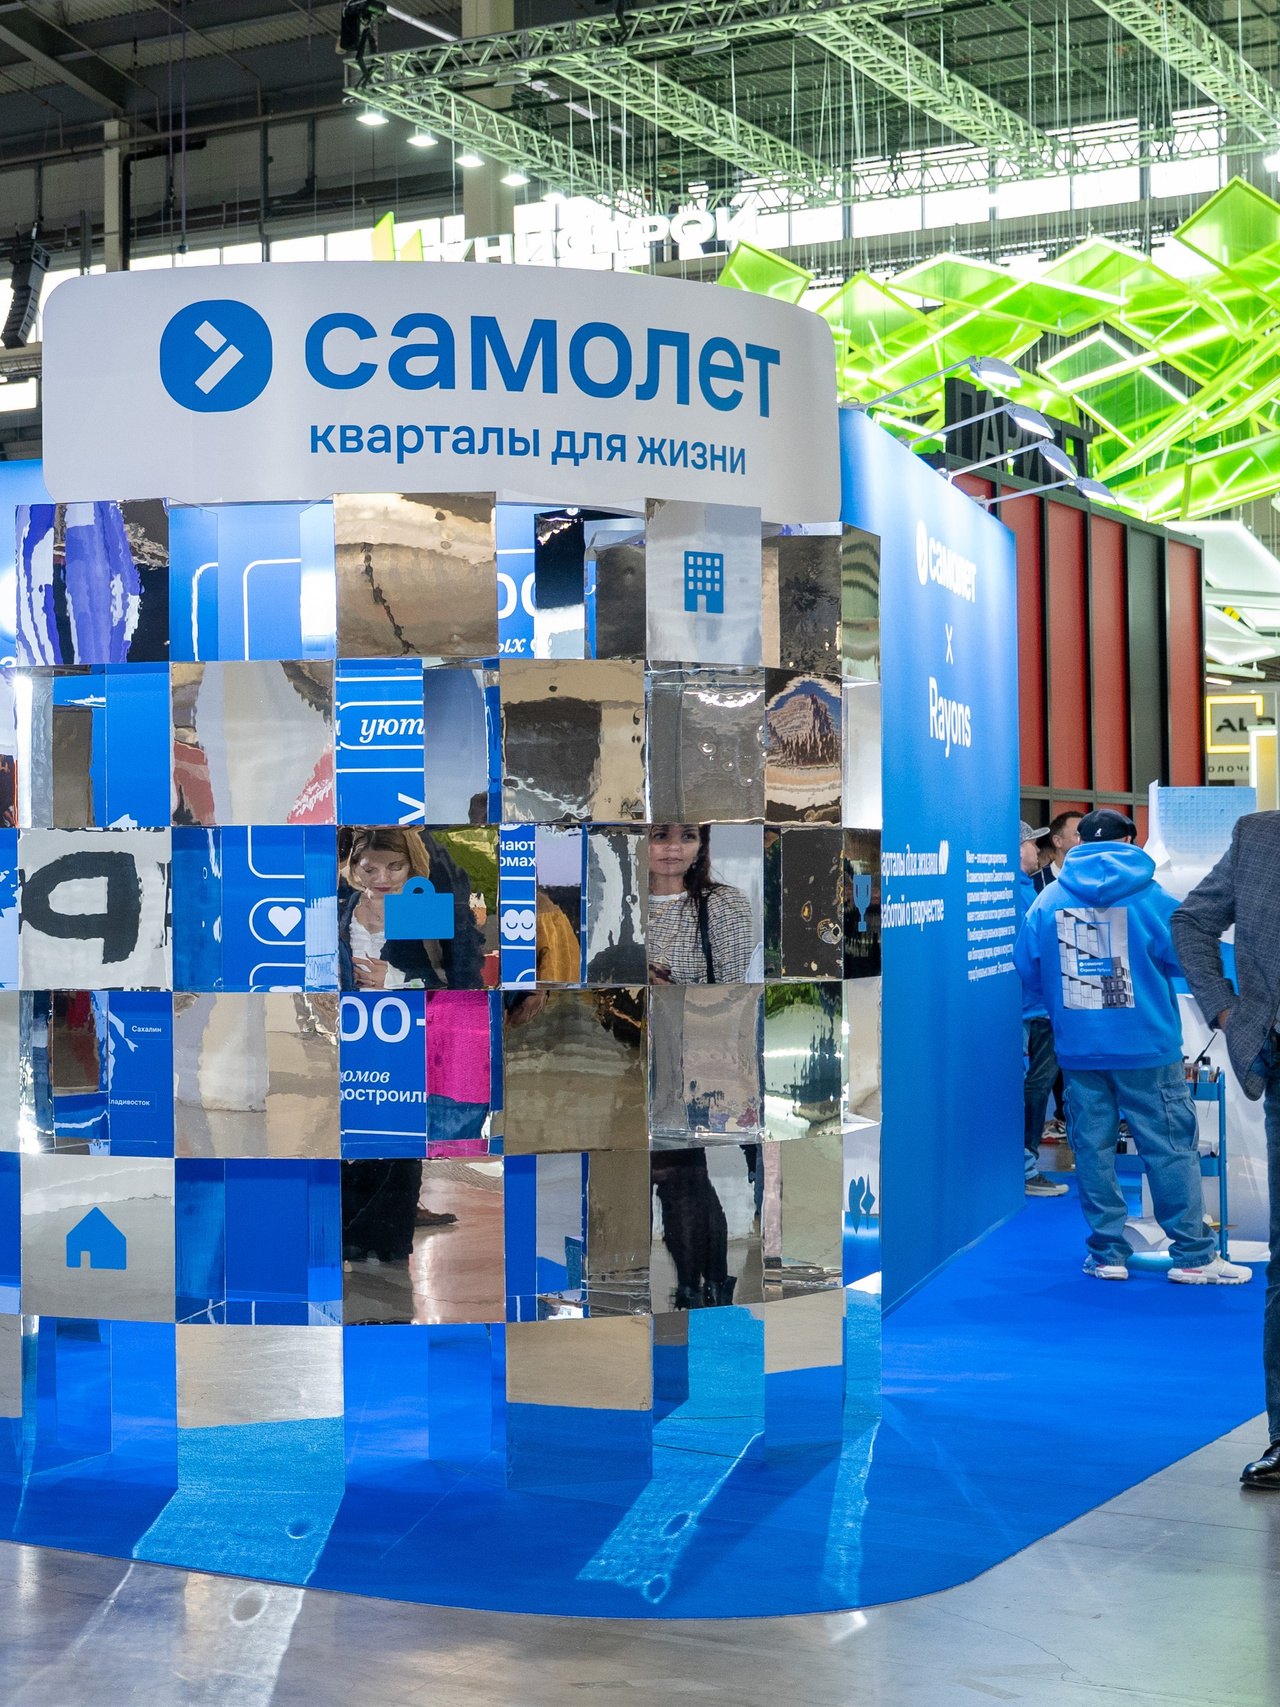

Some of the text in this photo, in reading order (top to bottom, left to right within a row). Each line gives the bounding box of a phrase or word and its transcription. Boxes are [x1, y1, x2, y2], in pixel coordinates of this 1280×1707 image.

[305, 312, 780, 418] самолет
[310, 424, 746, 475] кварталы для жизни
[929, 537, 976, 603] самолет
[929, 677, 971, 758] Rayons
[881, 852, 906, 886] арталы
[131, 1025, 162, 1034] Сахалин
[109, 1098, 150, 1107] ладивосток
[340, 1088, 426, 1106] остроил
